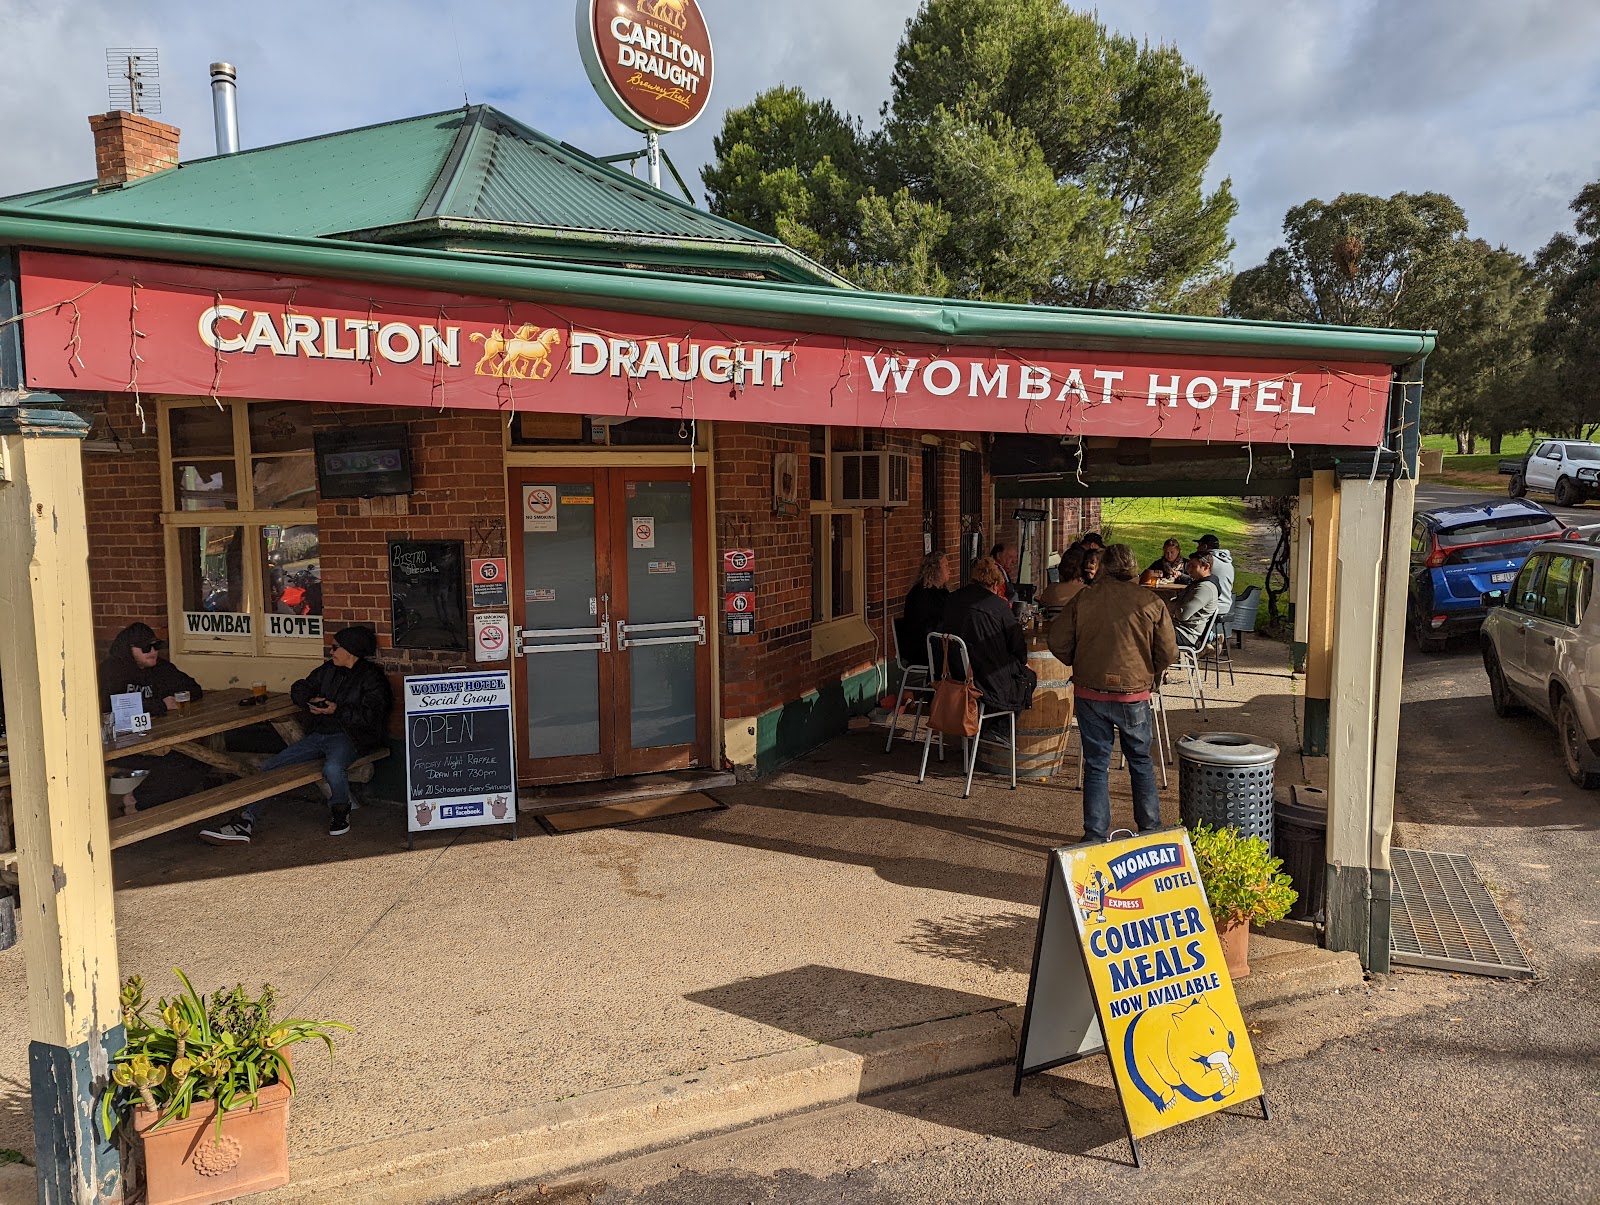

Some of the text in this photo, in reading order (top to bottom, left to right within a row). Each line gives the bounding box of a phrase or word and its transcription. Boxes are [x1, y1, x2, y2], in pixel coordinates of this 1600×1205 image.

[646, 19, 668, 32] SINCE
[610, 16, 706, 77] CARLTON
[617, 43, 700, 95] DRAUGHT
[626, 72, 692, 104] Brewery Fresh
[198, 304, 792, 387] CARLTON DRAUGHT
[862, 355, 1316, 416] WOMBAT HOTEL
[330, 453, 397, 479] BINGO
[393, 545, 427, 567] BISTRO
[483, 569, 494, 577] 18
[187, 614, 324, 635] WOMBAT HOTE
[410, 679, 505, 695] WOMBAT HOTEL
[419, 693, 498, 708] Social Group
[134, 715, 148, 727] 39
[412, 712, 474, 748] OPEN
[413, 758, 441, 770] FRIDAY
[467, 753, 498, 764] RAFFLE
[425, 768, 497, 780] DRAW AT 730pm
[1112, 847, 1176, 879] WOMBAT
[1153, 871, 1196, 893] HOTEL
[1108, 899, 1140, 909] EXPRESS
[1089, 906, 1206, 958] COUNTER
[1108, 940, 1206, 993] MEALS
[1109, 973, 1220, 1019] NOW AVAILABLE
